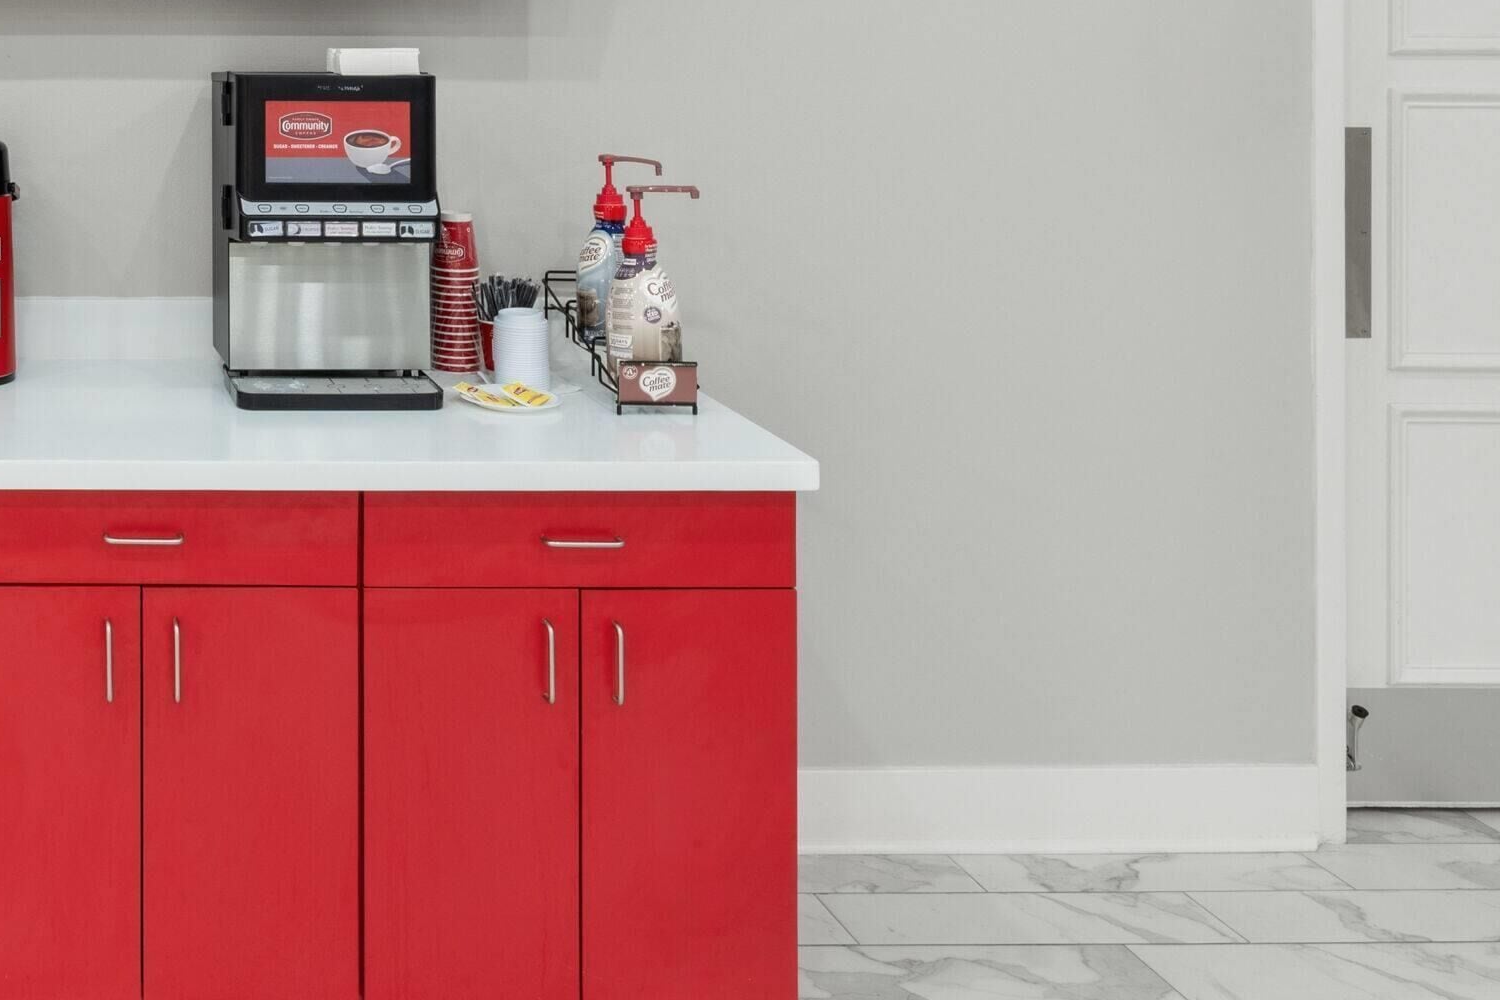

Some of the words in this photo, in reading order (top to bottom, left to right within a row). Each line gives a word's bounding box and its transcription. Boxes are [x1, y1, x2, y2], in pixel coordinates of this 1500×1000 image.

[282, 120, 329, 132] Community
[642, 376, 671, 387] Coffee
[649, 382, 671, 391] mate
